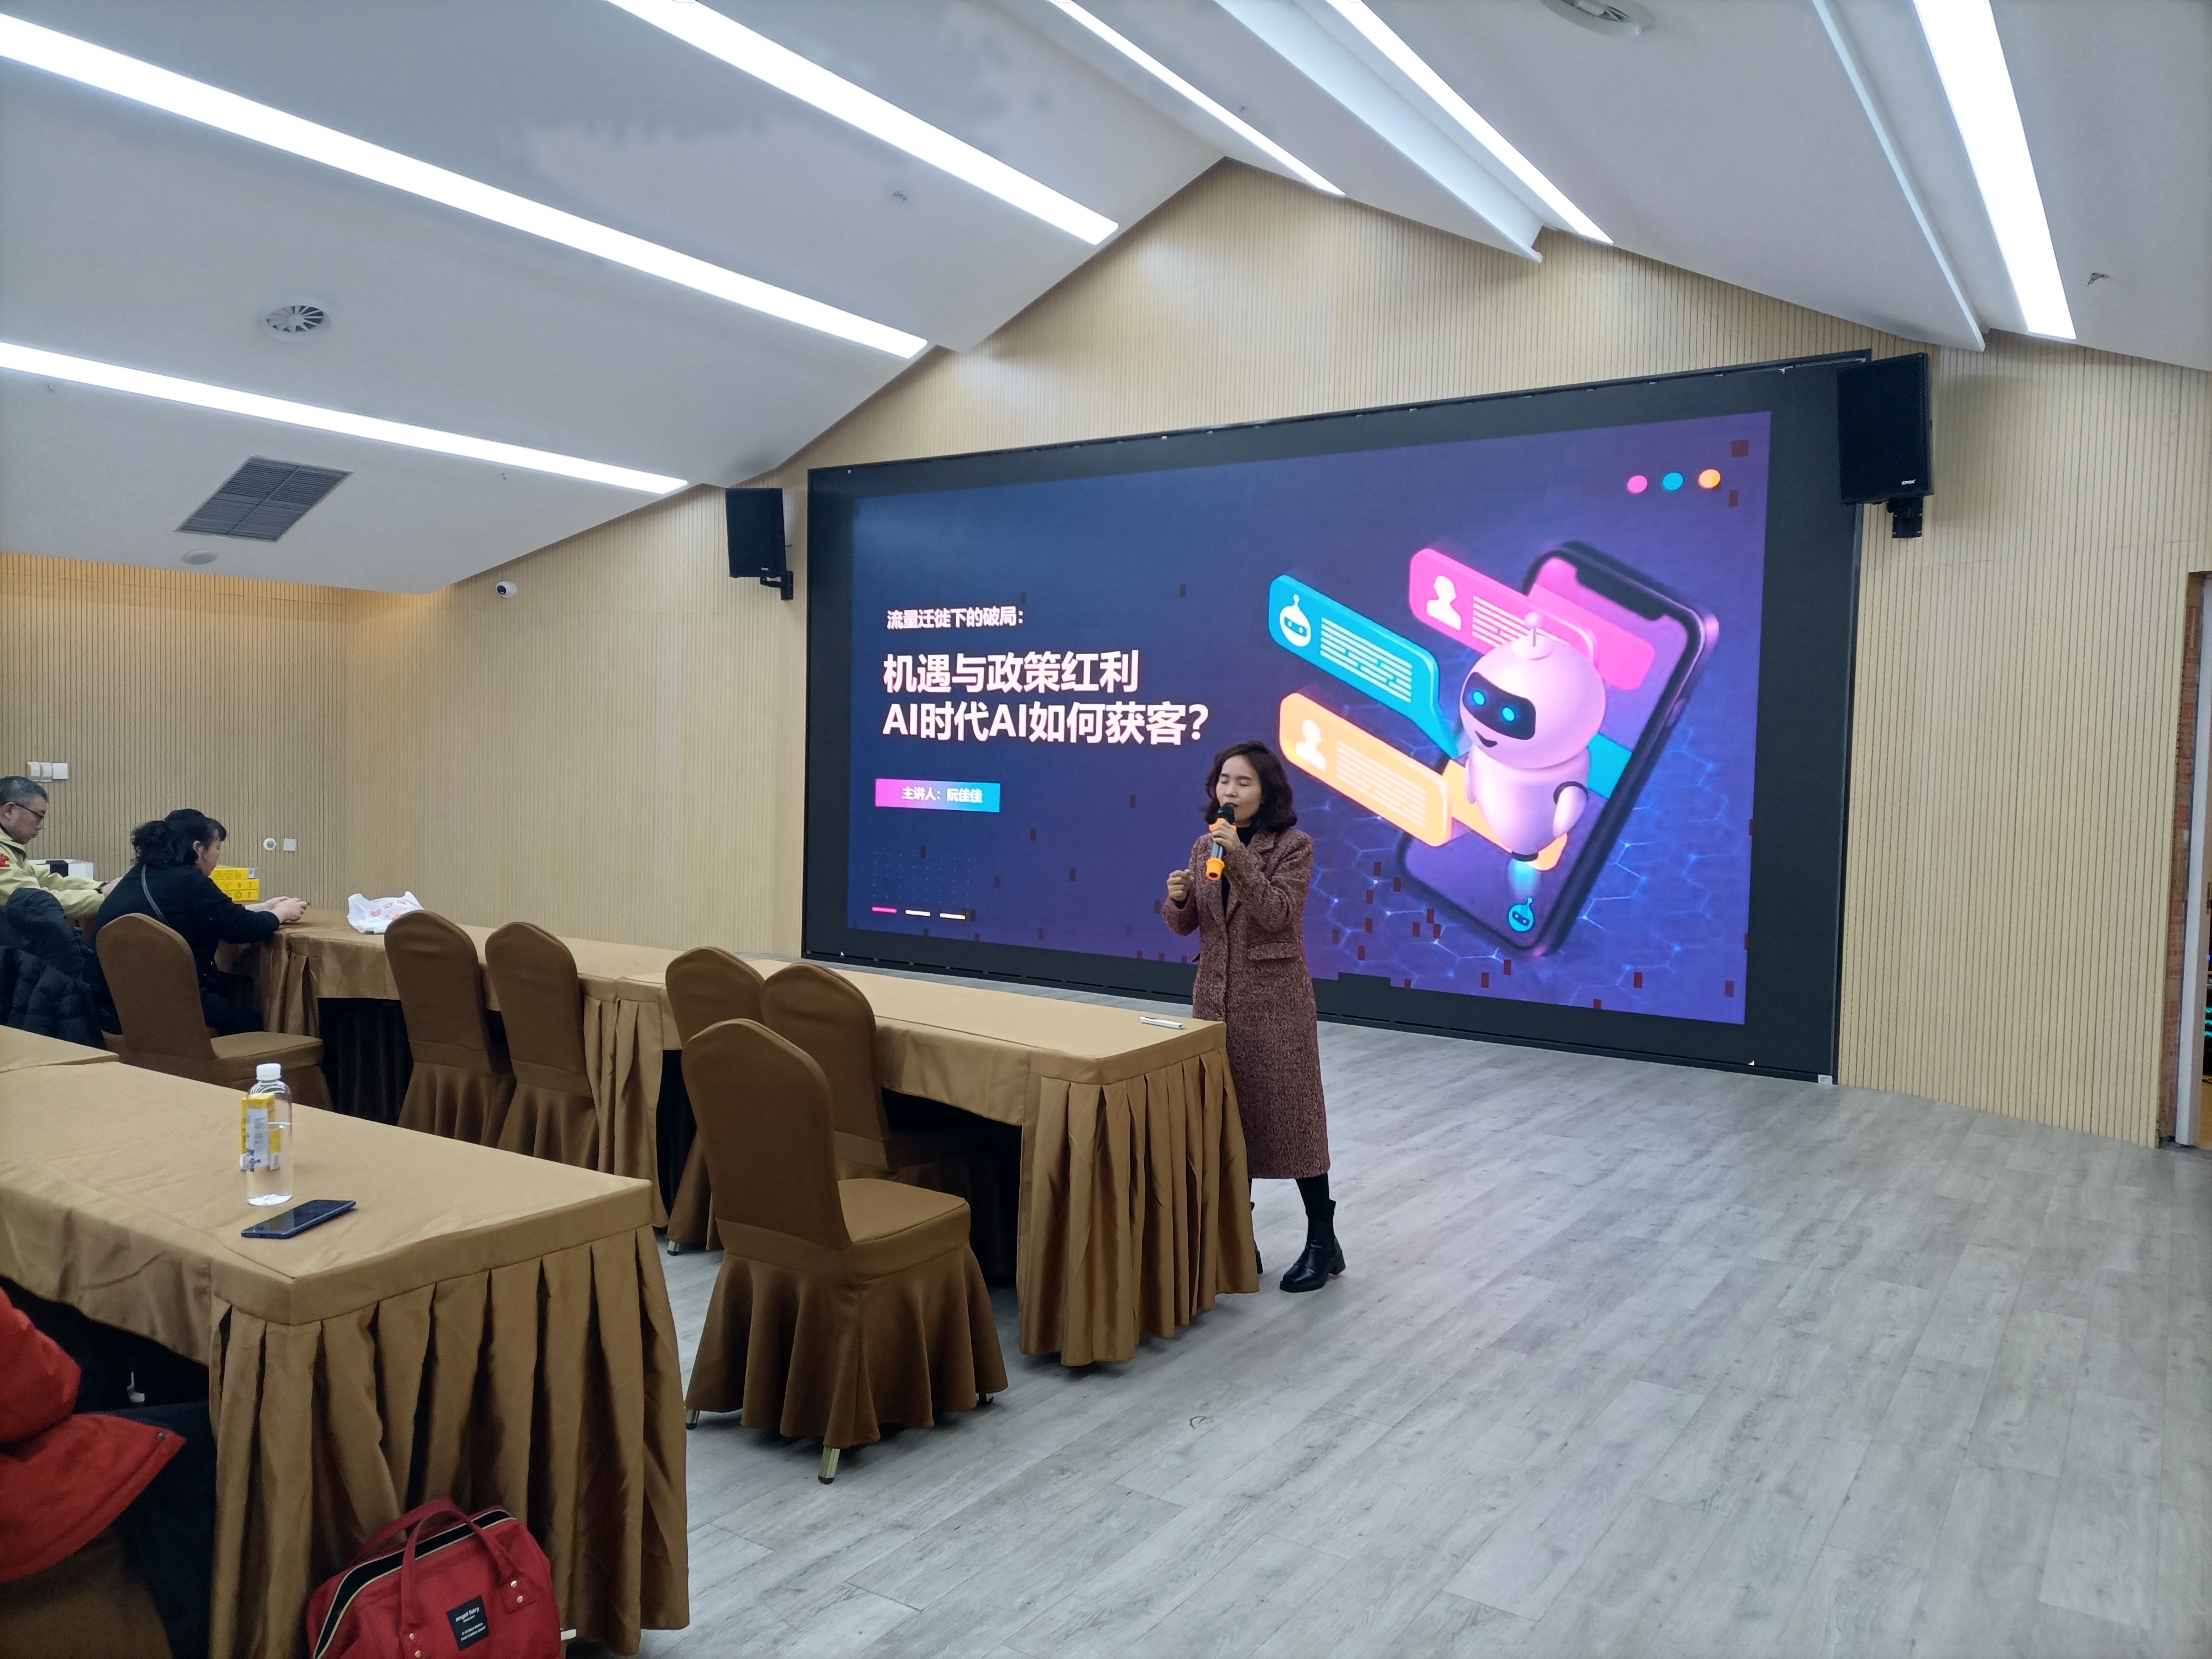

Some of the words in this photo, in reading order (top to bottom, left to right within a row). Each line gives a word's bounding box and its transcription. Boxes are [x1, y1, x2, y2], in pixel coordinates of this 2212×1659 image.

[883, 650, 1139, 693] 机遇与政策红利
[882, 701, 1209, 745] AI时代AI如何获客？
